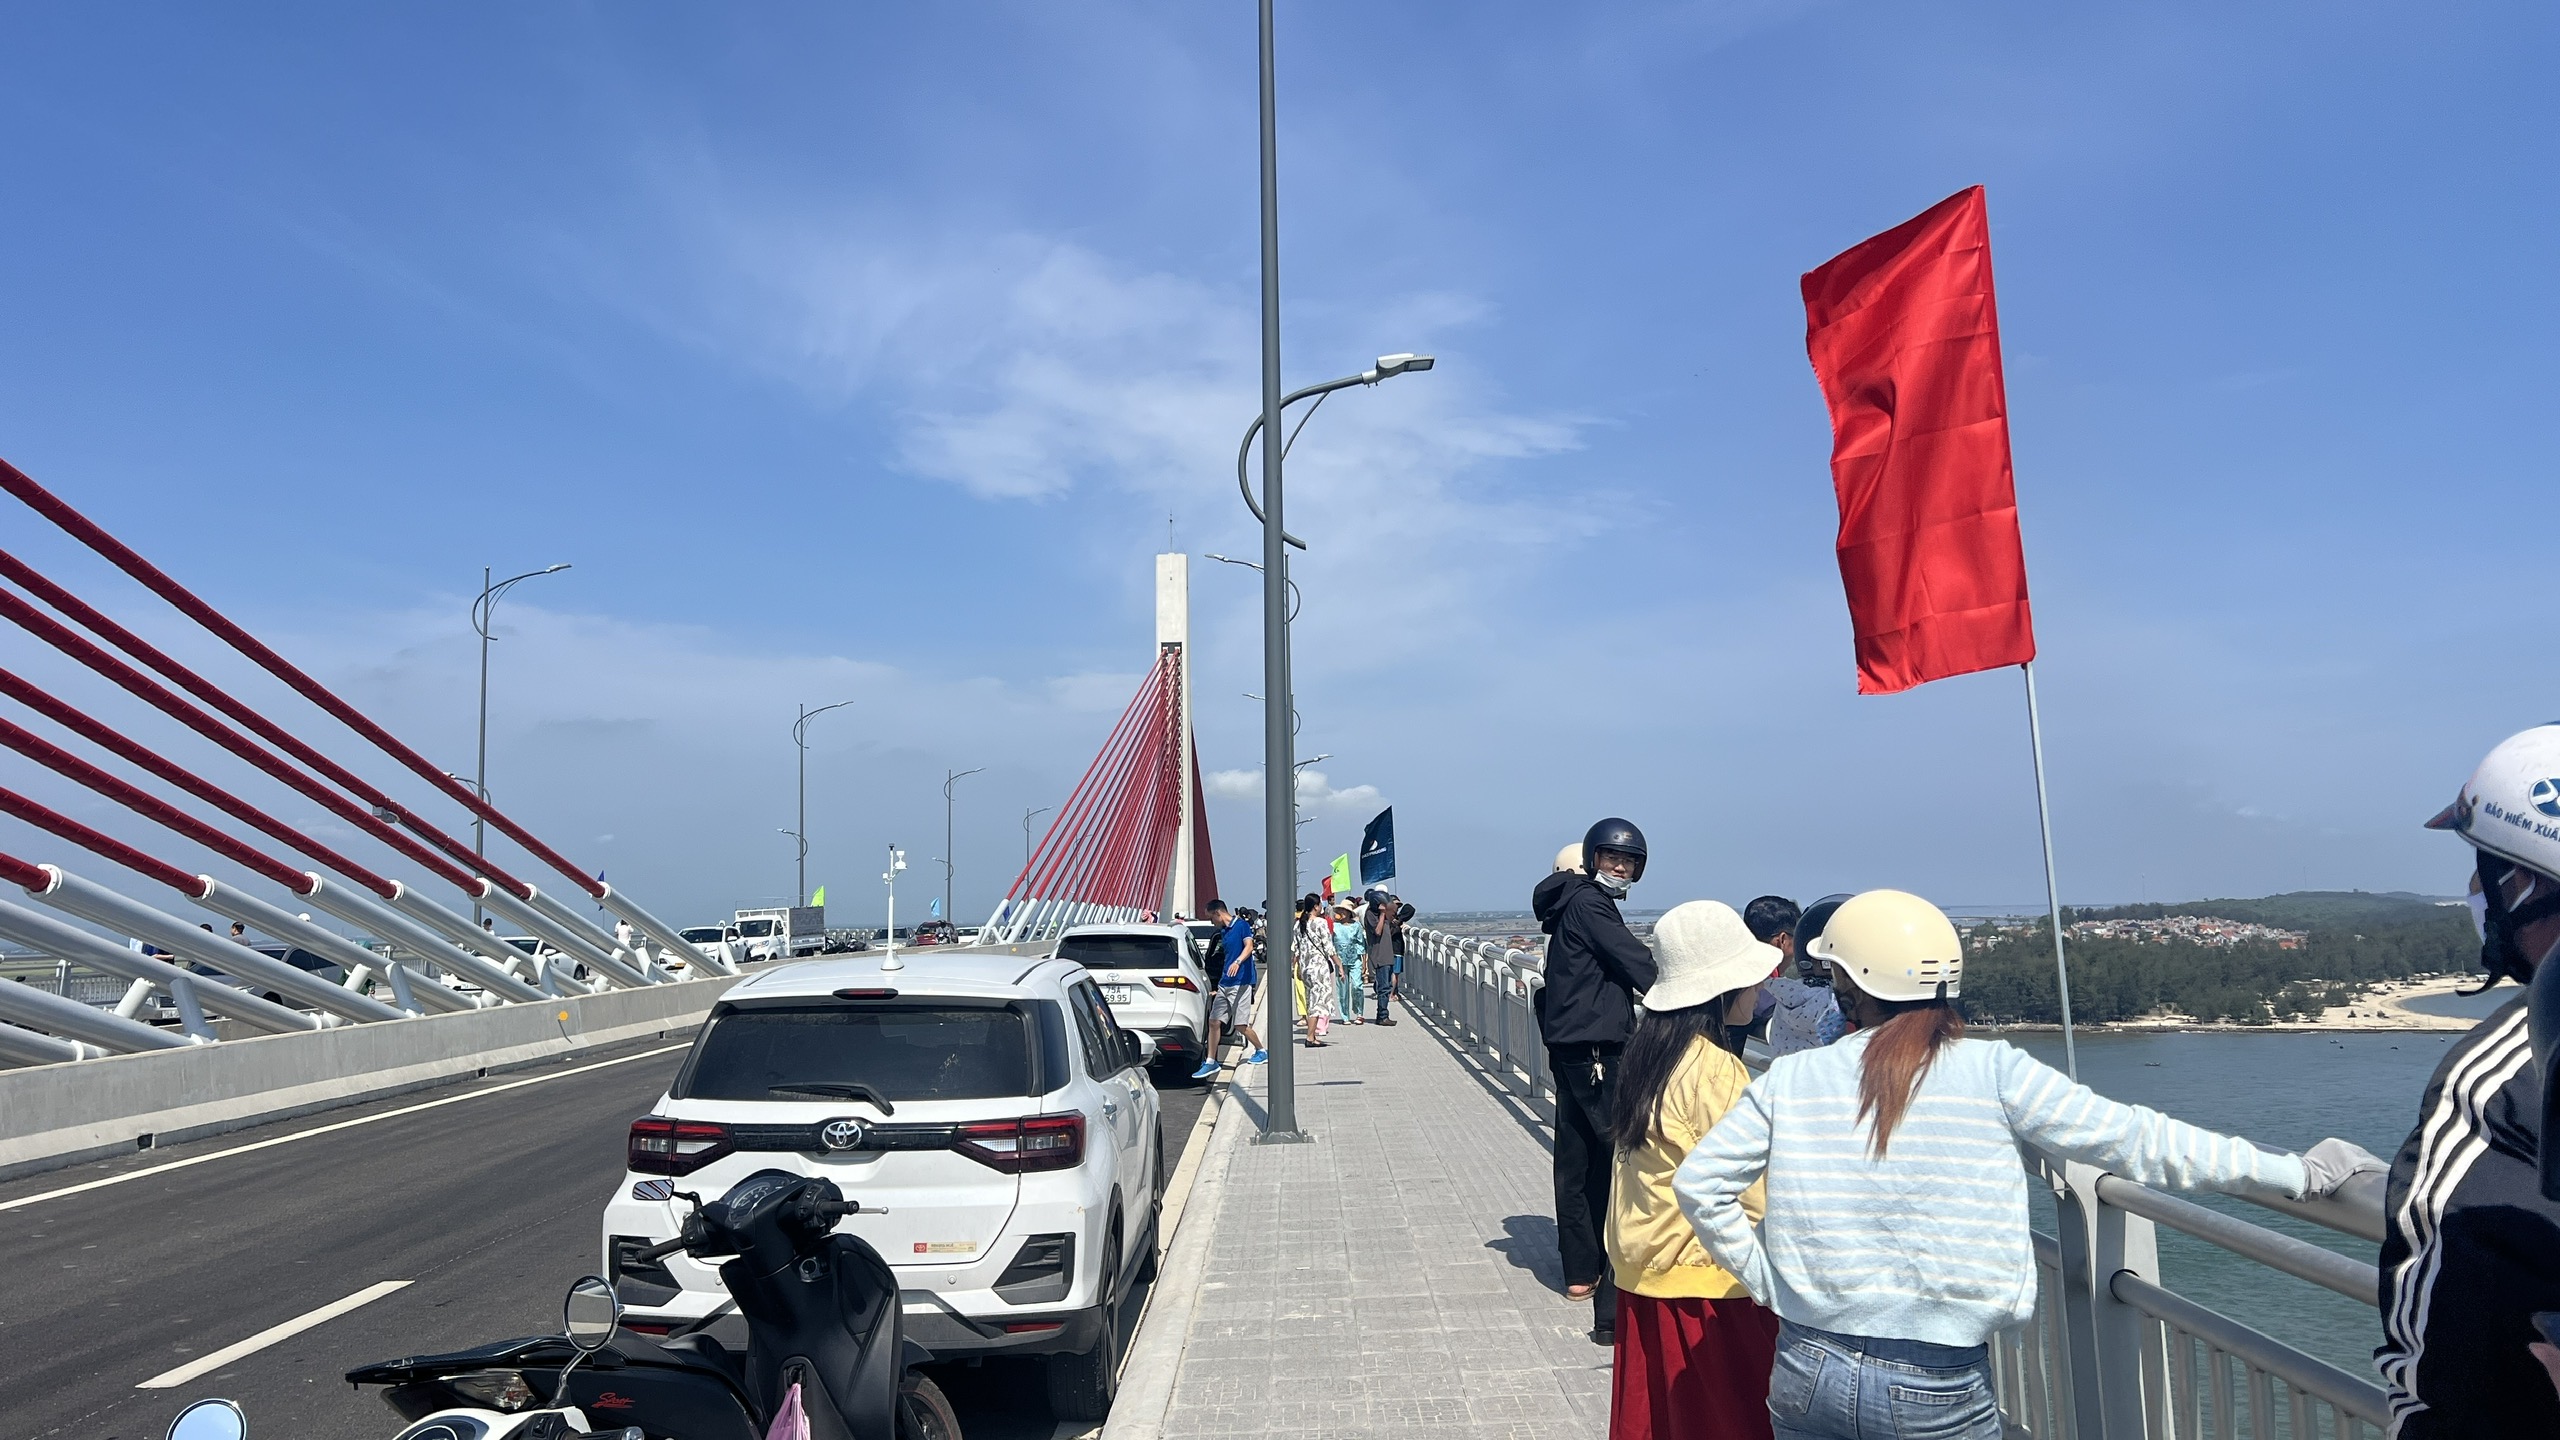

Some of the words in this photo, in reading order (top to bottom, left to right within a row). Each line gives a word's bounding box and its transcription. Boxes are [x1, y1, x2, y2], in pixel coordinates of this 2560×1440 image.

[2485, 802, 2503, 819] BẢO
[2504, 811, 2533, 831] HIỂM
[2534, 823, 2560, 842] XUÂ
